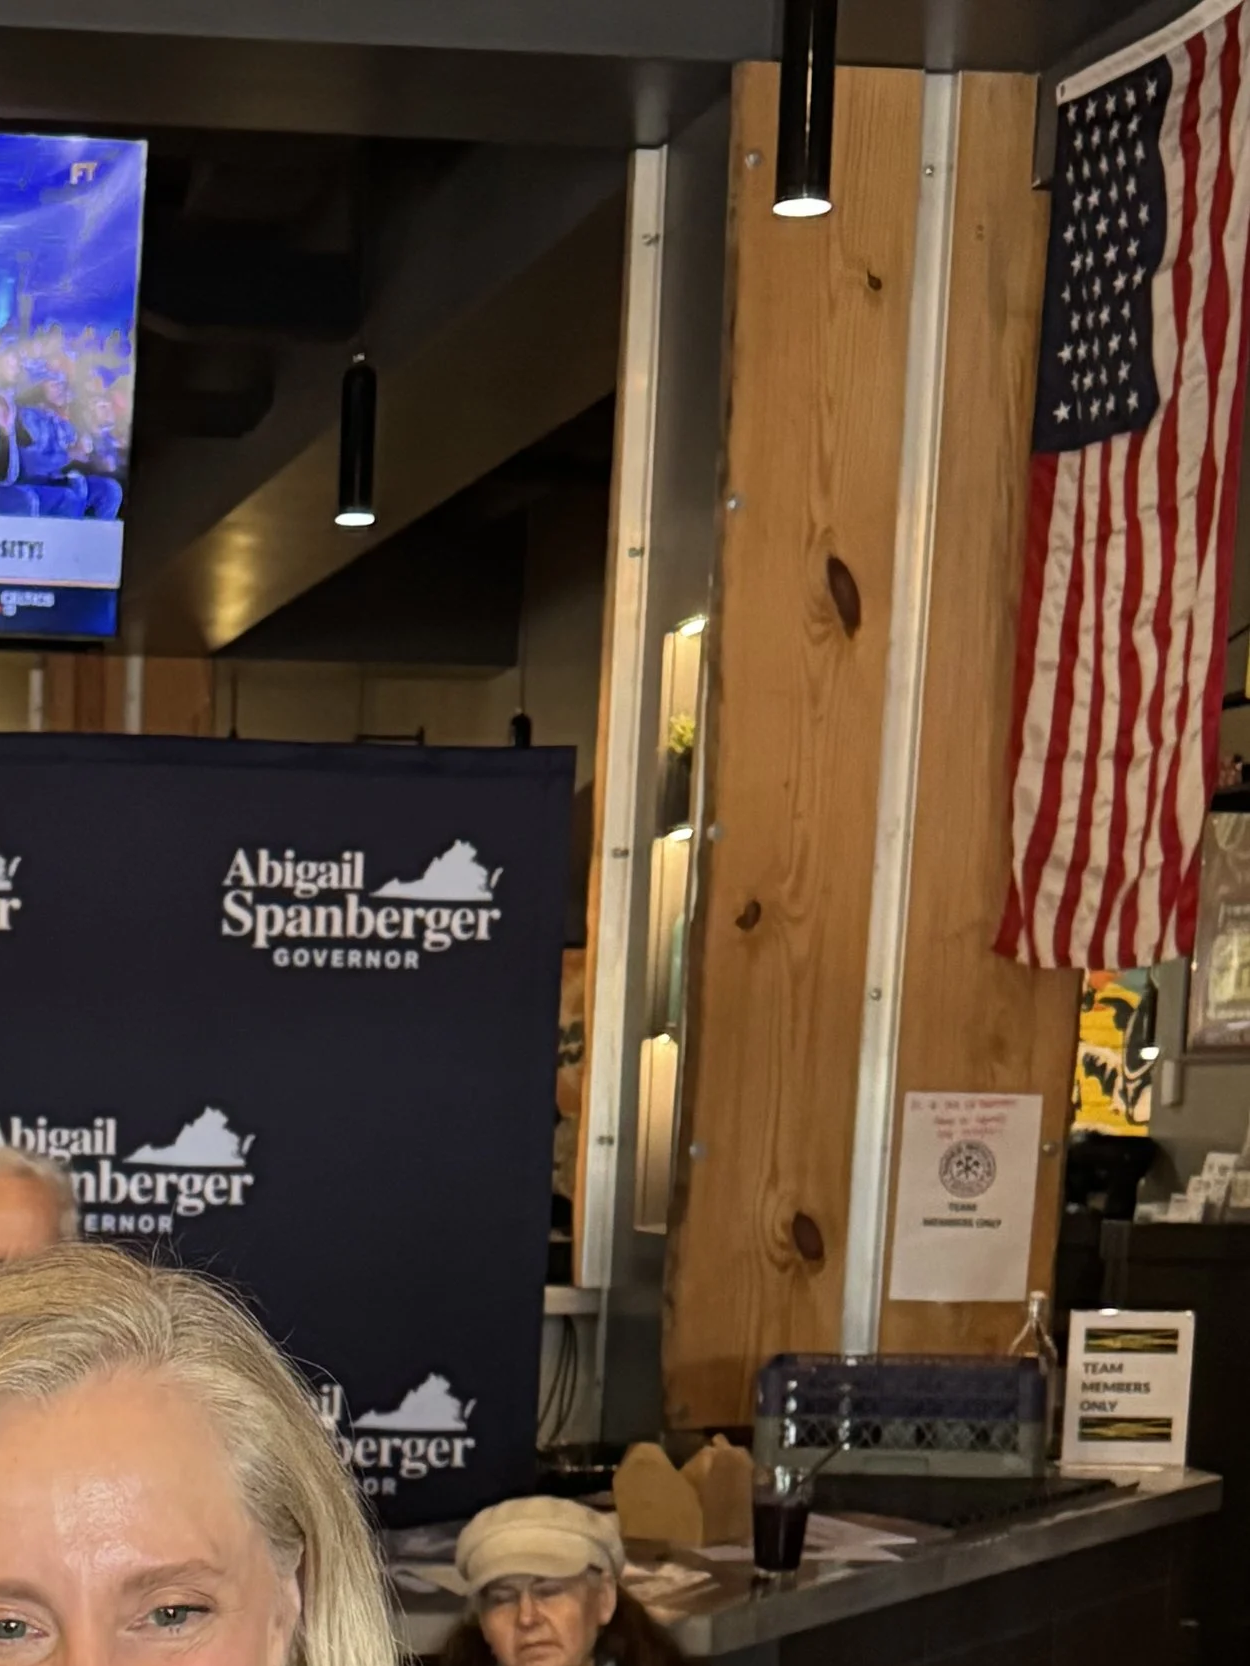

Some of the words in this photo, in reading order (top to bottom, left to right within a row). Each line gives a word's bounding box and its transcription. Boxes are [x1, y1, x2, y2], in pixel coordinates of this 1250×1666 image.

[221, 848, 365, 898] Abigail
[221, 890, 502, 951] Spanberger
[273, 947, 420, 970] GOVERNOR
[70, 1159, 254, 1217] nberger
[84, 1213, 172, 1234] ERNOR
[1082, 1362, 1124, 1375] TEAM
[1080, 1381, 1151, 1394] MEMBERS
[1079, 1400, 1119, 1413] ONLY
